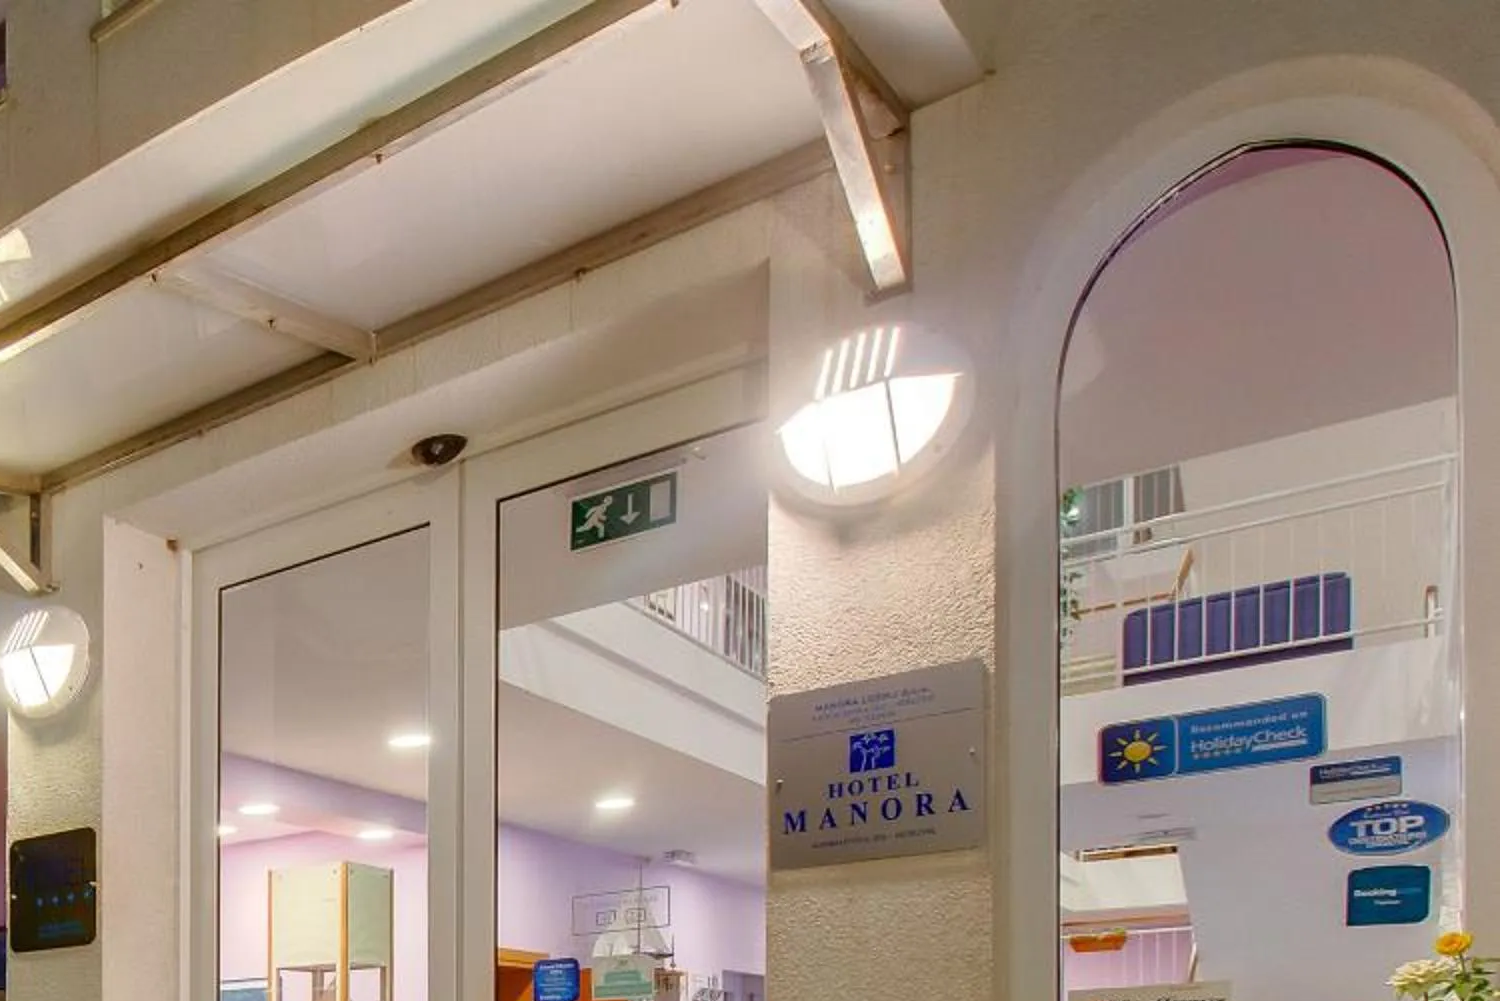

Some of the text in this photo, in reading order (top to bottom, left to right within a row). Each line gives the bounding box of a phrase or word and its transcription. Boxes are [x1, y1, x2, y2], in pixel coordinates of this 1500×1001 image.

[1190, 725, 1309, 753] HolidayCheck
[828, 771, 920, 799] HOTEL
[783, 788, 972, 835] MANORA
[1348, 815, 1426, 837] TOP
